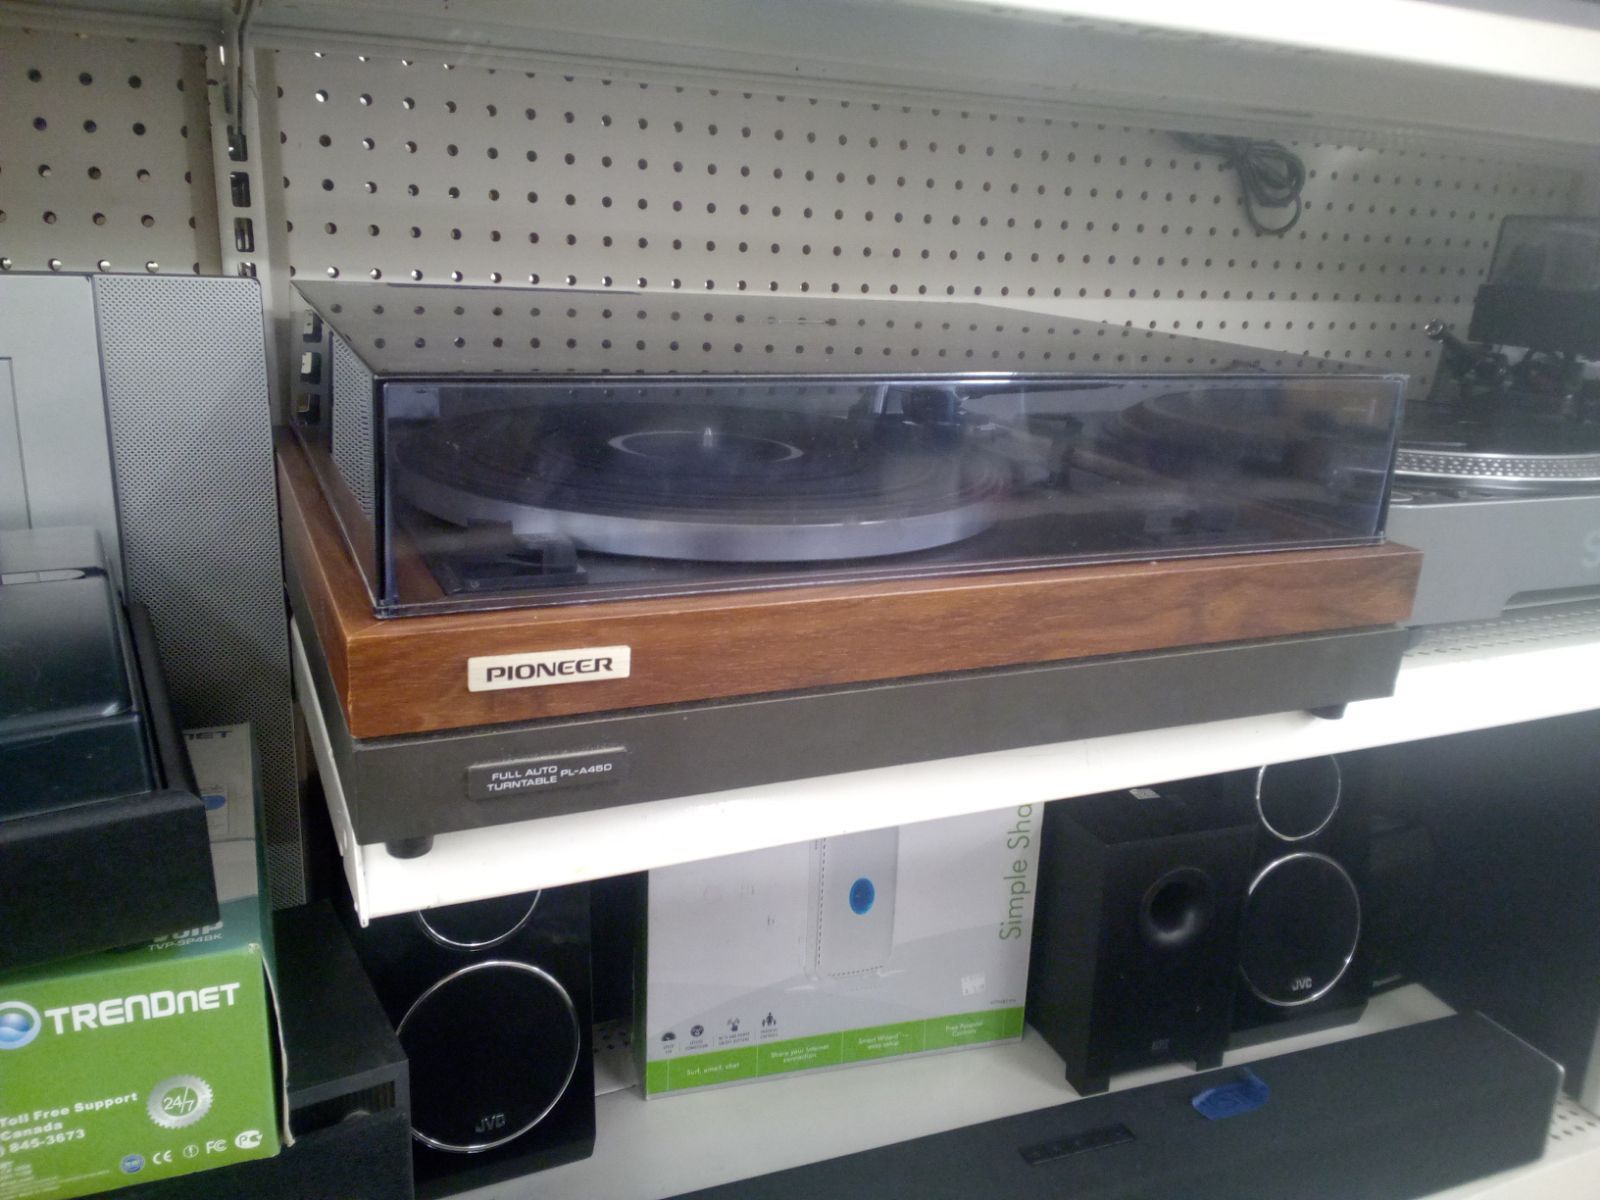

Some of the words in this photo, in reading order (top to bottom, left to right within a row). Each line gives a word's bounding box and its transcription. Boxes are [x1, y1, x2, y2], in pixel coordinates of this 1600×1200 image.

[486, 657, 613, 682] PIONEER
[491, 771, 522, 781] FULL
[525, 765, 558, 776] AUTO
[487, 775, 557, 791] TURNTABLE
[999, 859, 1030, 940] Simple
[1292, 978, 1313, 991] JVC
[33, 1110, 69, 1120] Free
[74, 1092, 138, 1112] Support
[163, 1087, 194, 1113] 24/7
[0, 1122, 63, 1140] Canada
[475, 1113, 506, 1132] JVC
